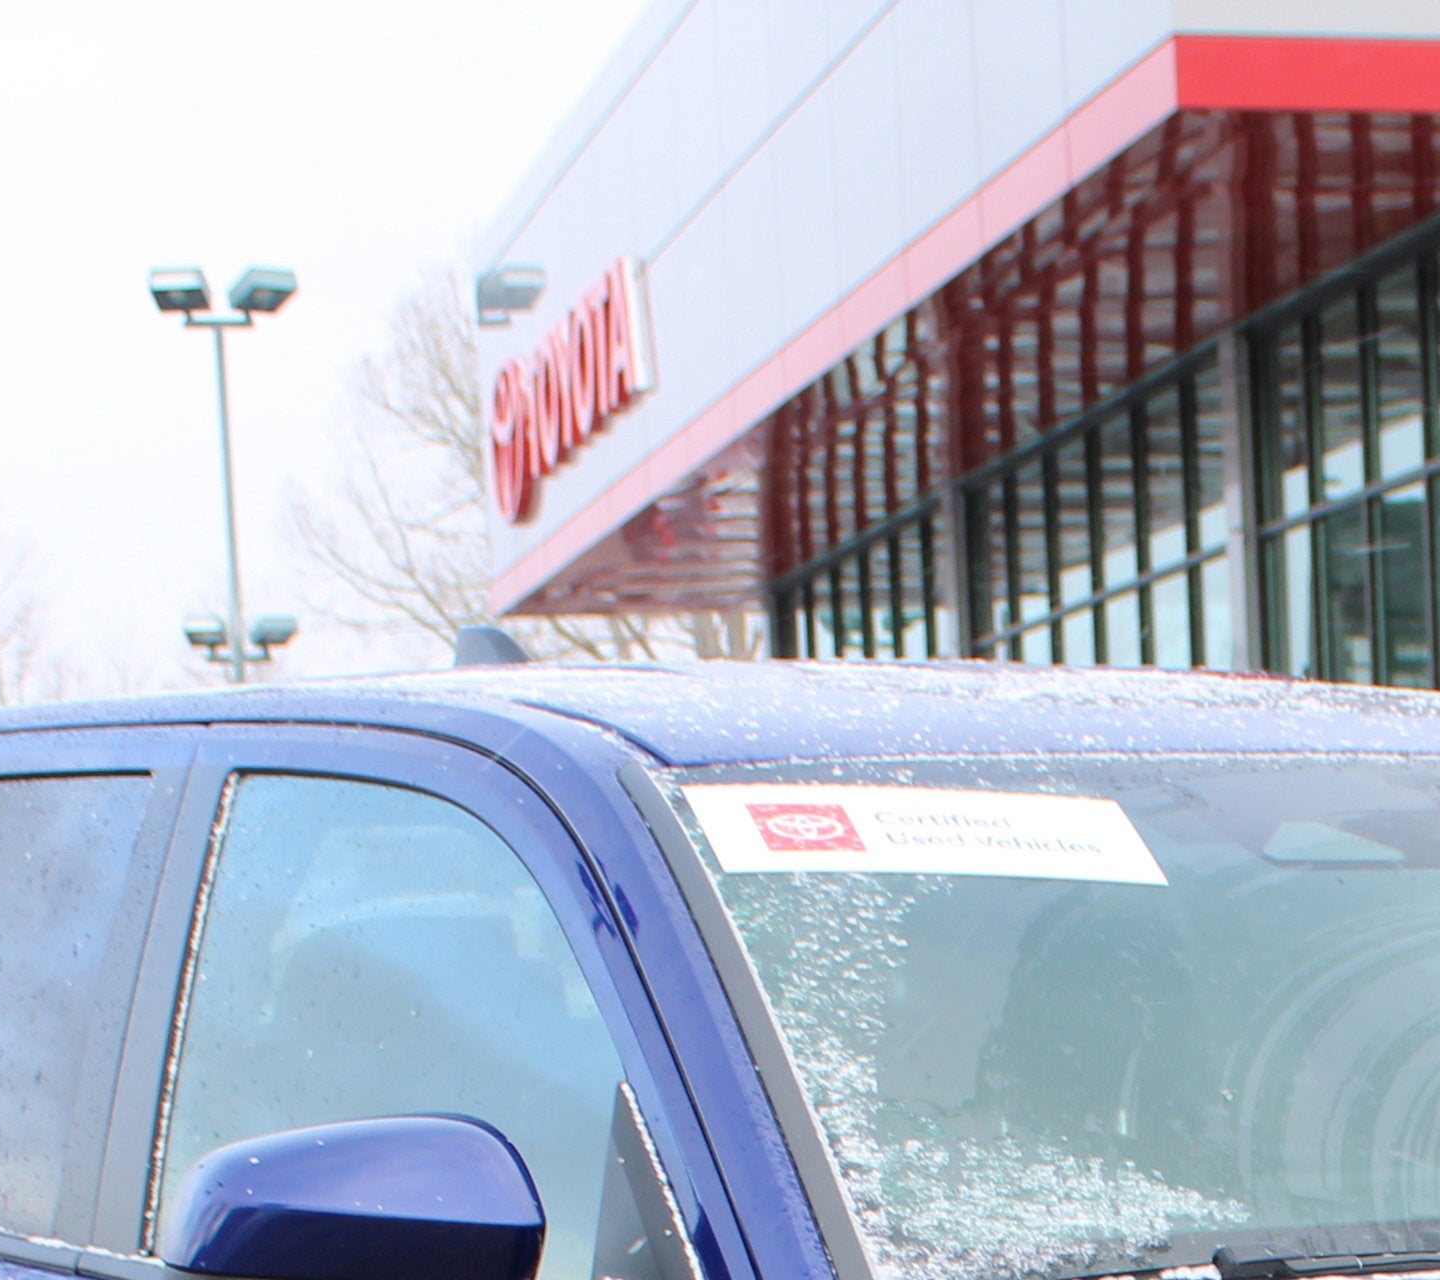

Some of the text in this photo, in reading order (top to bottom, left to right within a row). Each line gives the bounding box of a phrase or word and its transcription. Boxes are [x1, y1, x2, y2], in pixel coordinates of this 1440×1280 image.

[513, 255, 648, 478] TOYOTA
[875, 811, 1011, 829] Certified
[885, 831, 1103, 854] Used Vehicles
